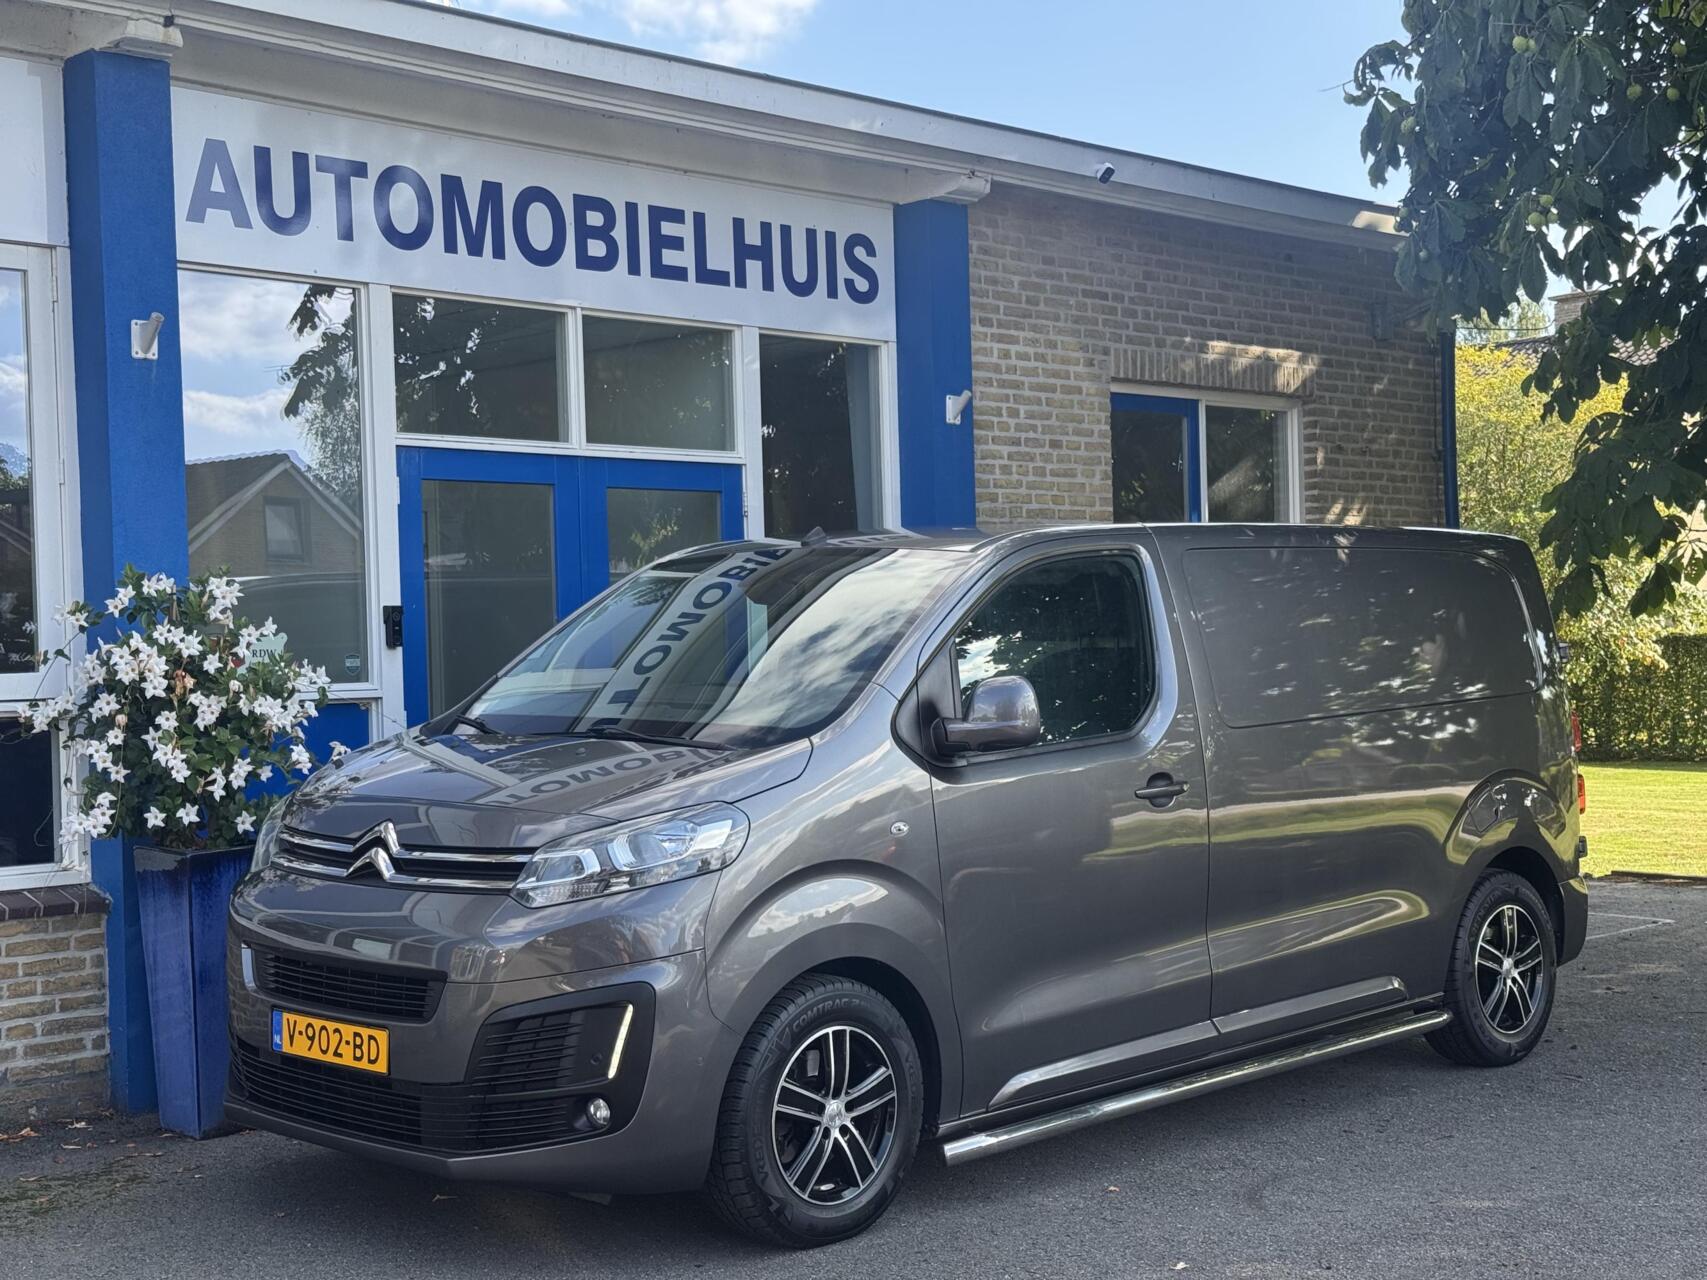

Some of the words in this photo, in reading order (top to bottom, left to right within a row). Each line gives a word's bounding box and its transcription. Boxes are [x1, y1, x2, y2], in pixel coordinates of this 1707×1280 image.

[185, 138, 880, 304] AUTOMOBIELHUIS
[251, 649, 277, 659] RDW
[286, 1017, 380, 1065] V-902-BD
